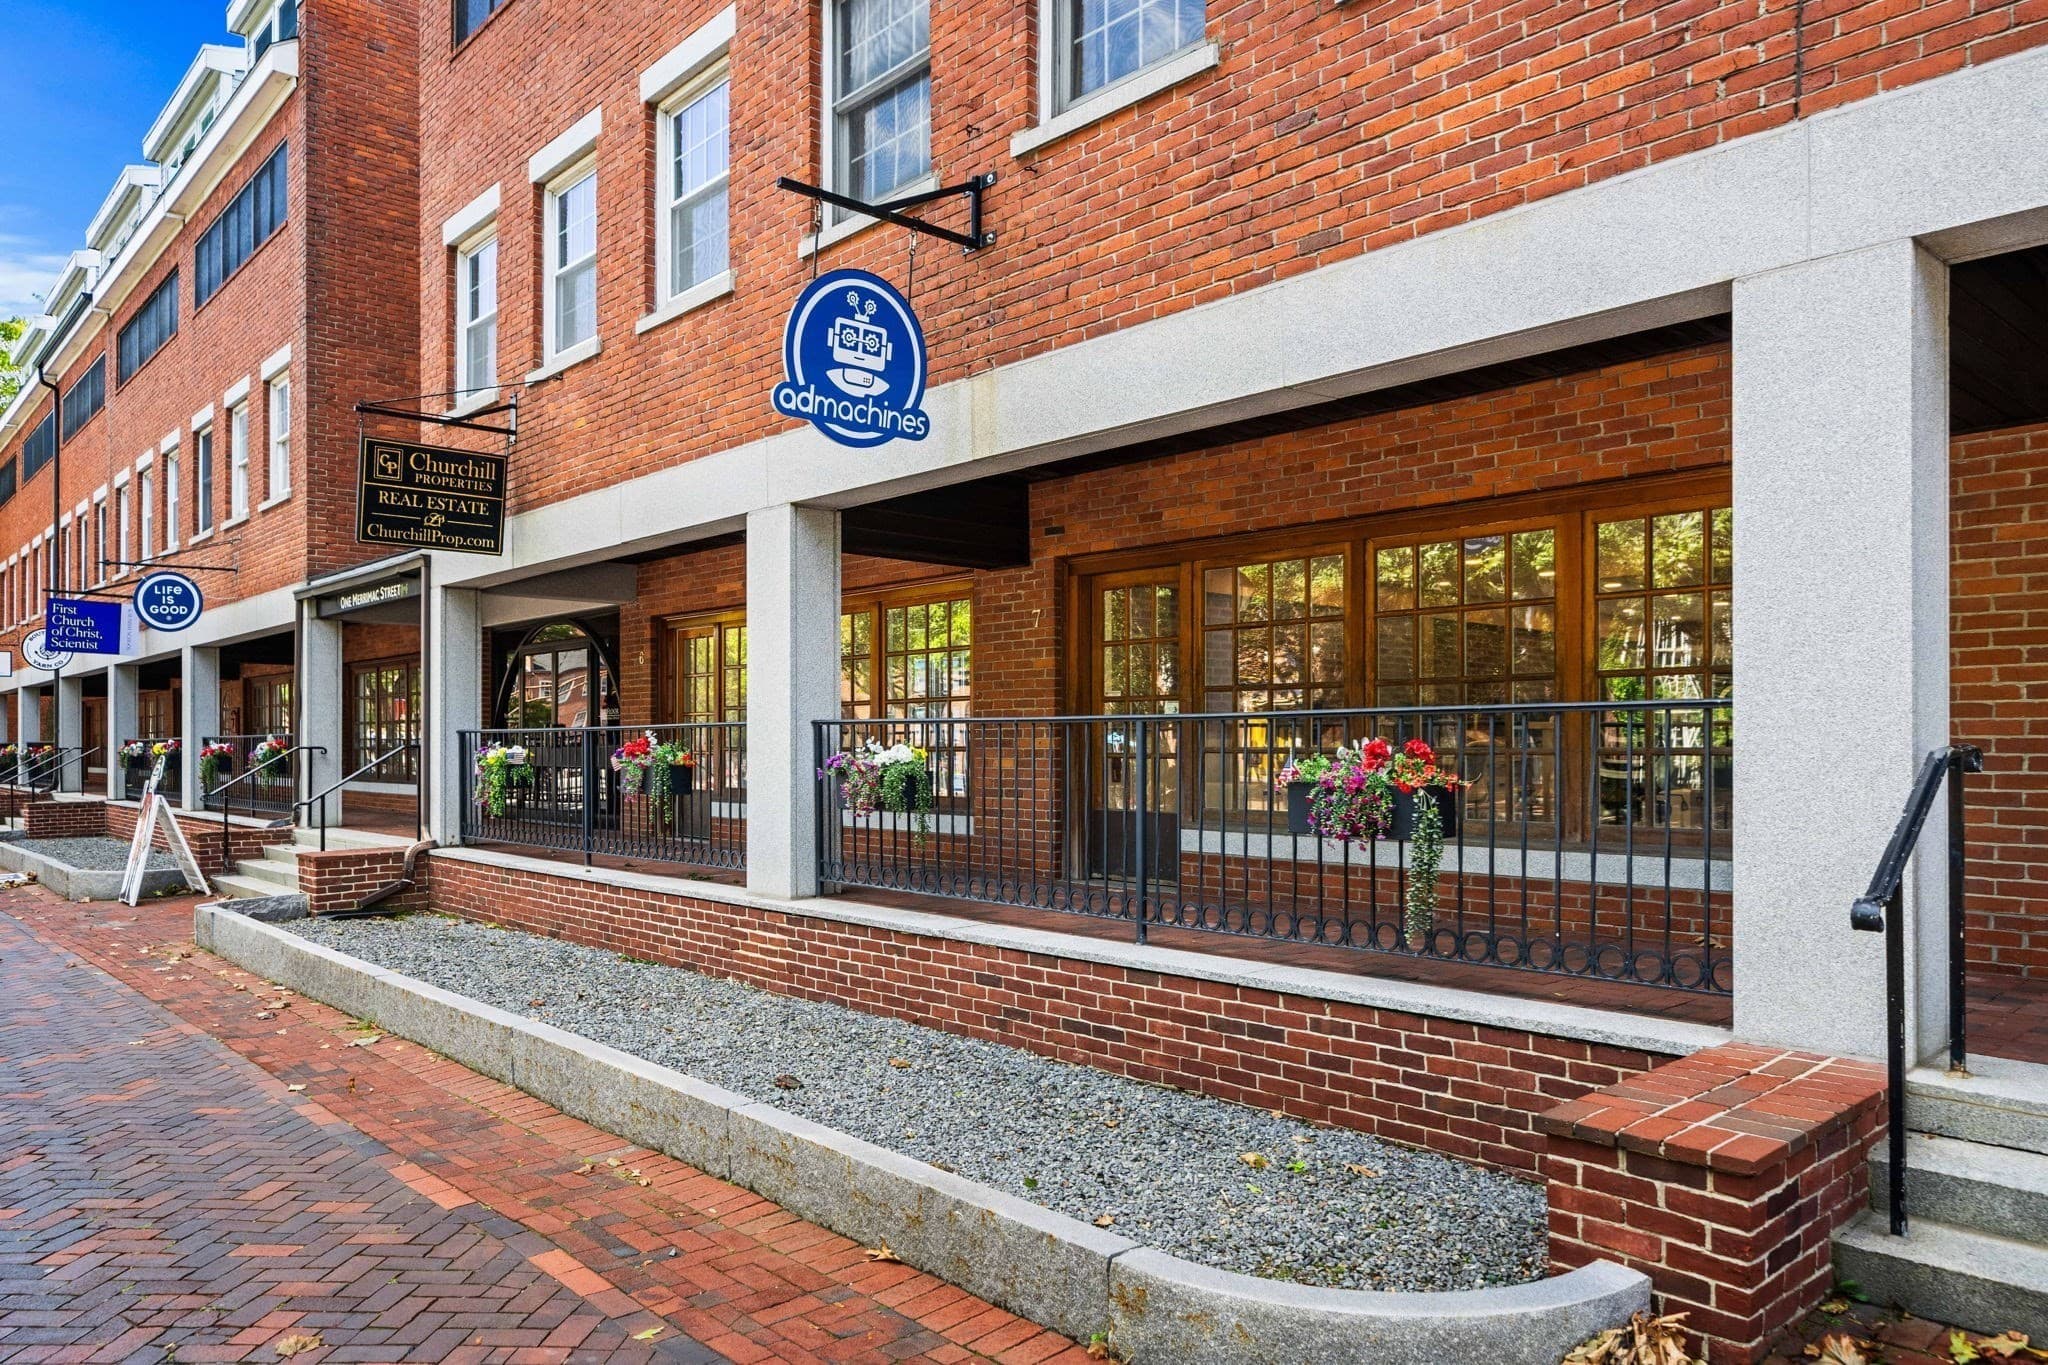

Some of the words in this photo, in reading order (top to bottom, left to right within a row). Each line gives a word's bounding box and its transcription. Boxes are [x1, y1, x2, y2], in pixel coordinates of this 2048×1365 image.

[779, 384, 926, 435] admachines
[409, 452, 497, 480] Churchill
[415, 473, 493, 492] PROPERTIES
[378, 490, 423, 508] REAL
[427, 496, 489, 516] ESTATE
[367, 523, 495, 548] ChurchillProp.com
[162, 596, 175, 605] IS
[340, 596, 352, 609] ONE
[379, 583, 401, 600] STREET
[52, 603, 77, 615] First
[149, 605, 188, 615] GOOD
[1031, 609, 1041, 628] 7
[51, 614, 95, 627] Church
[51, 626, 64, 637] of
[50, 636, 98, 650] Scientist
